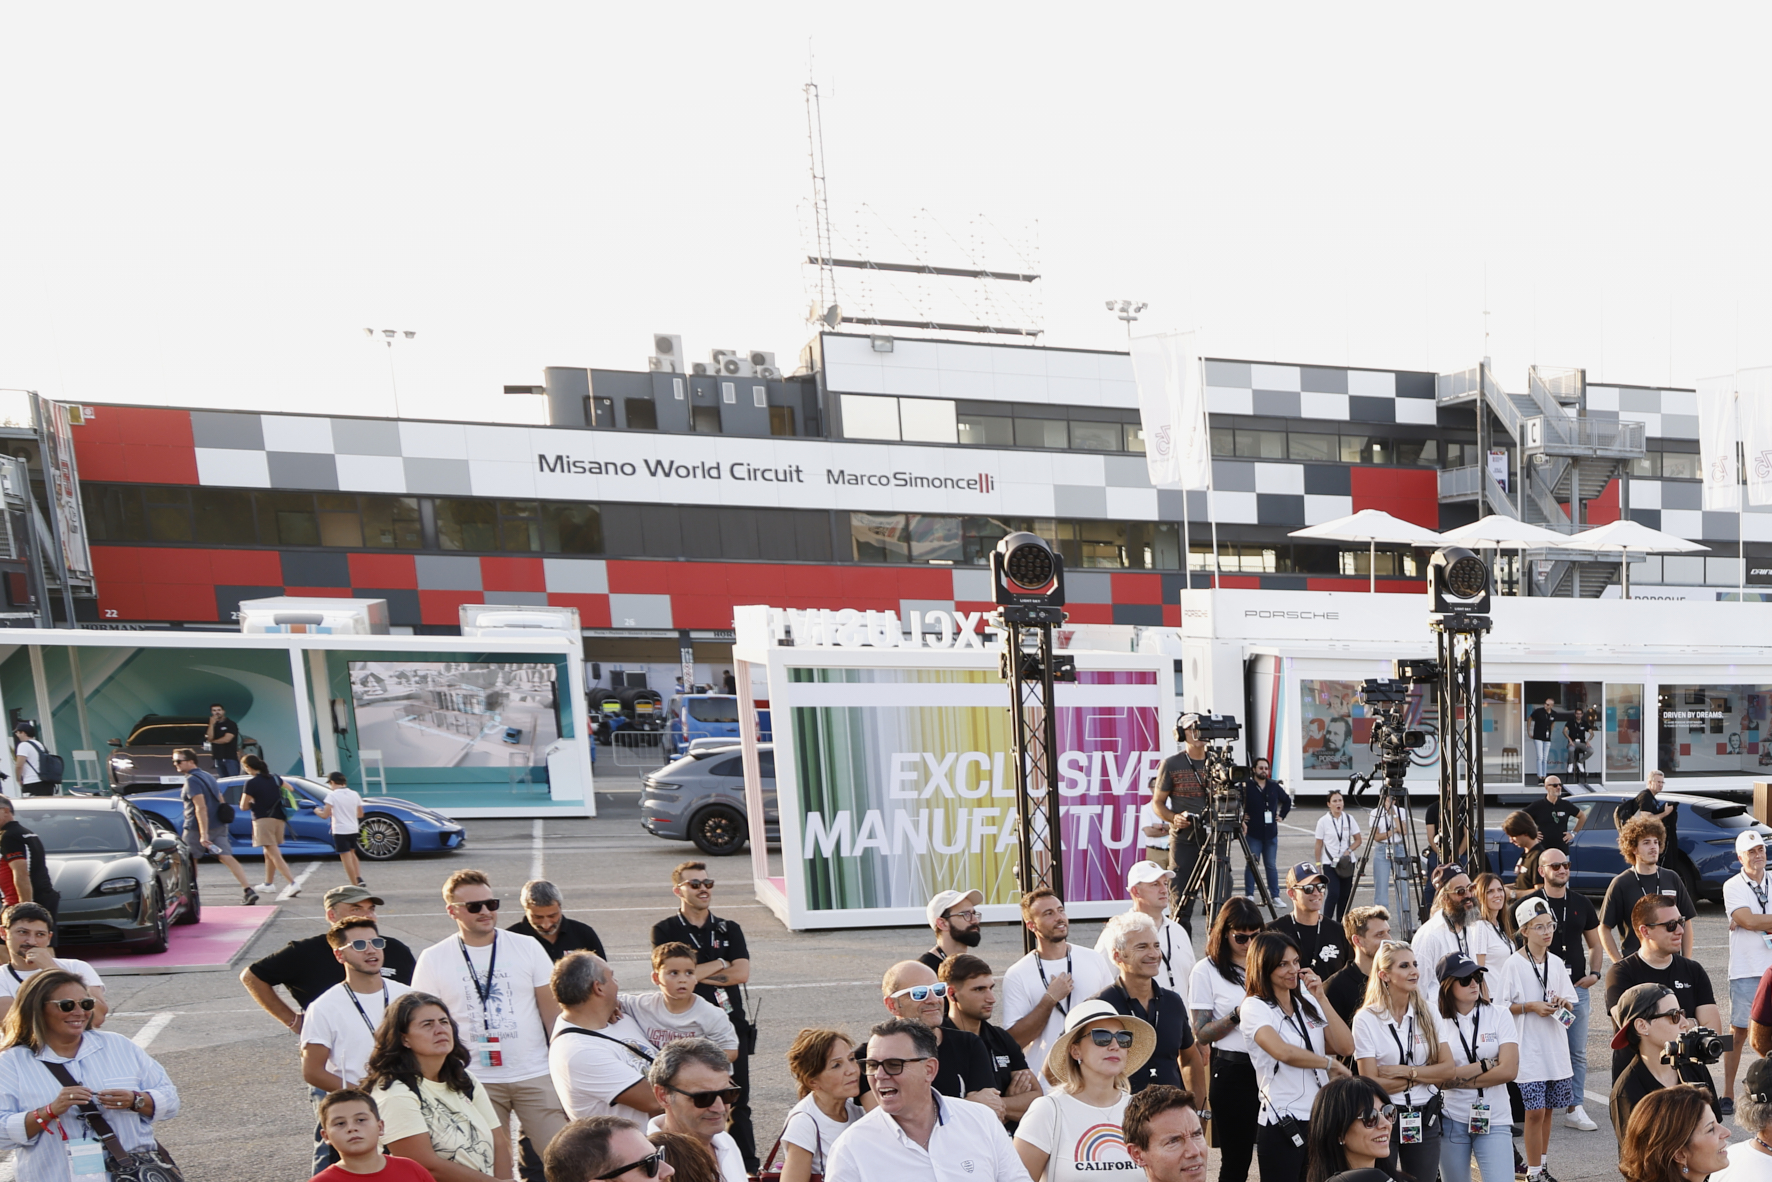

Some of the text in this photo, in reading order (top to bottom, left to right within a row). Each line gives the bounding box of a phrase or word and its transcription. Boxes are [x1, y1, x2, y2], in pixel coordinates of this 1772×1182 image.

[1531, 422, 1537, 443] C
[537, 454, 994, 494] Misano World Circuit Marco Simoncelli
[105, 610, 118, 618] 22
[1244, 610, 1340, 620] PORSCHE
